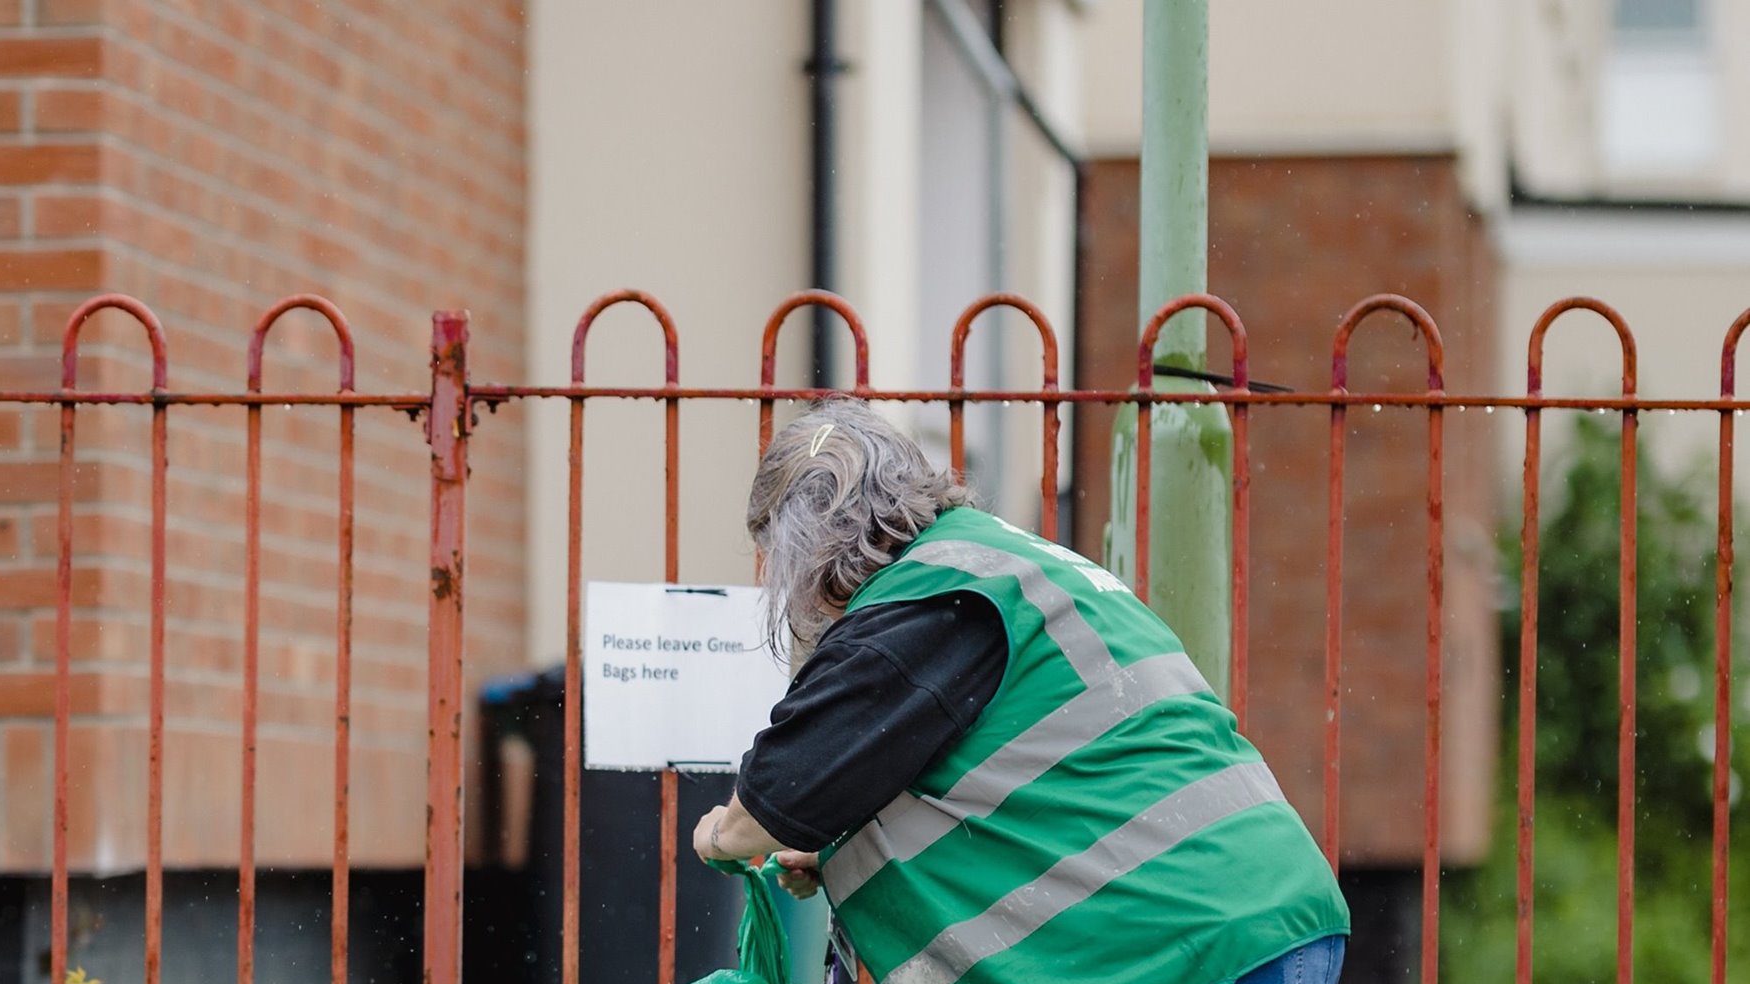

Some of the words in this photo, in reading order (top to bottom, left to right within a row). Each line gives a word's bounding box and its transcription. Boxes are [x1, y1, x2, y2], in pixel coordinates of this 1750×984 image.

[602, 634, 652, 650] Please
[657, 635, 702, 652] leave
[707, 637, 745, 653] Green
[602, 662, 637, 682] Bags
[642, 663, 679, 681] here
